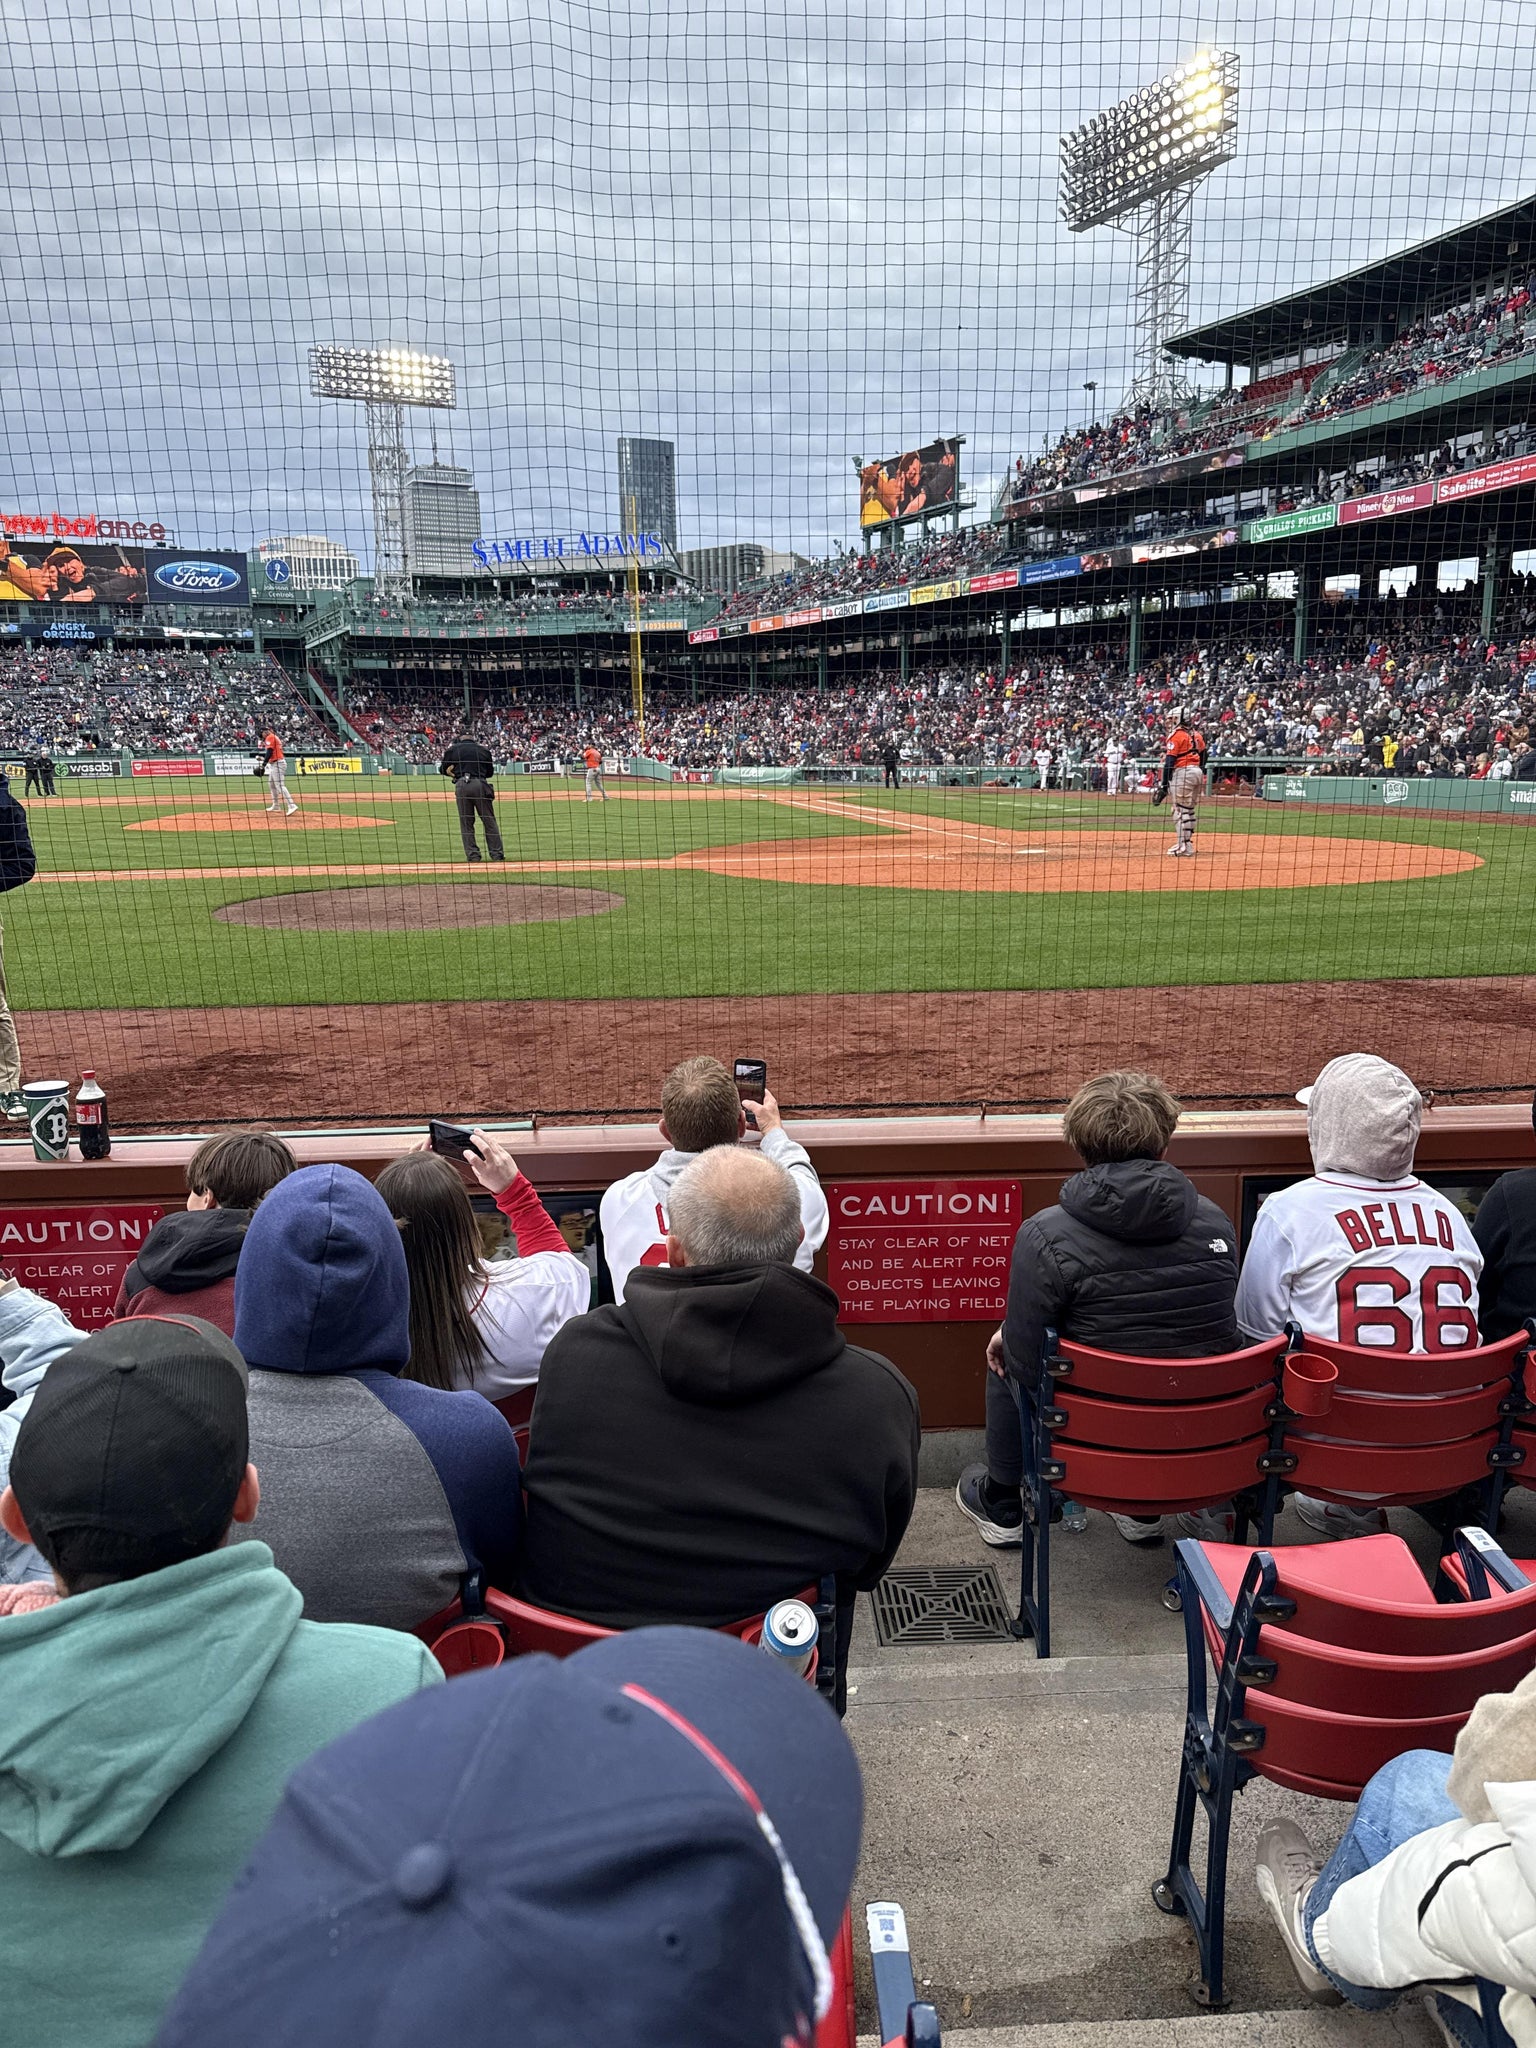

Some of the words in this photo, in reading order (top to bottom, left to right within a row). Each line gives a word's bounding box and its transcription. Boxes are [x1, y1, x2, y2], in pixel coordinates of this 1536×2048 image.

[1440, 477, 1486, 497] Safelite
[1357, 502, 1382, 514] Ninety
[1396, 494, 1414, 506] Nine
[52, 511, 165, 540] balance
[1263, 519, 1295, 535] GRILLO'S
[1298, 511, 1332, 528] PICKLES
[472, 537, 571, 568] SAMUEL
[575, 531, 663, 557] ADAMS
[172, 566, 223, 588] Ford
[43, 631, 95, 639] ORCHARD
[50, 623, 86, 631] ANGRY
[70, 760, 113, 773] wasabi
[308, 760, 336, 772] TWISTED
[337, 762, 350, 772] TEA
[47, 1113, 67, 1144] B
[840, 1193, 1010, 1216] CAUTION!
[0, 1219, 153, 1244] AUTION
[1335, 1202, 1455, 1254] BELLO
[839, 1238, 876, 1250] STAY
[884, 1237, 939, 1248] CLEAR
[947, 1236, 971, 1248] OF
[979, 1236, 1011, 1247] NET
[0, 1267, 15, 1279] AY
[25, 1264, 84, 1278] CLEAR
[92, 1264, 117, 1276] OF
[841, 1258, 874, 1271] AND
[882, 1258, 904, 1270] BE
[911, 1257, 965, 1269] ALERT
[972, 1256, 1006, 1267] FOR
[57, 1285, 112, 1298] ALERT
[847, 1278, 923, 1291] OBJECTS
[932, 1277, 1001, 1289] LEAVING
[842, 1300, 874, 1311] THE
[882, 1298, 951, 1311] PLAYING
[959, 1298, 1006, 1309] FIELD
[1335, 1265, 1479, 1355] 66
